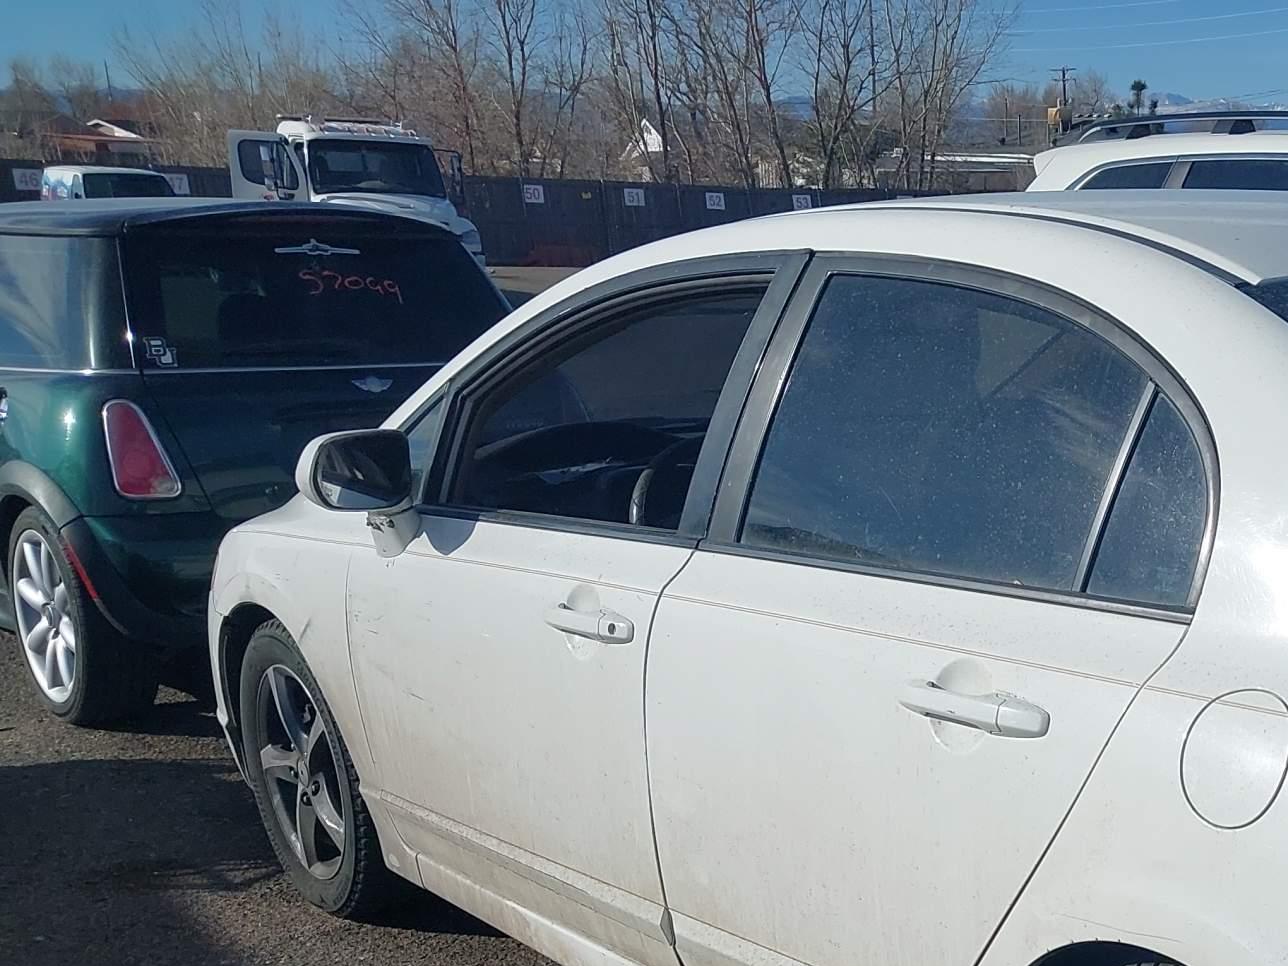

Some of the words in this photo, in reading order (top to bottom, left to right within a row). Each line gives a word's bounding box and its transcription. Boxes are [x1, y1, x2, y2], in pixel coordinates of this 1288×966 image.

[19, 172, 39, 189] 46
[525, 187, 541, 200] 50
[627, 191, 641, 203] 51
[708, 194, 722, 207] 52
[795, 196, 810, 209] 53
